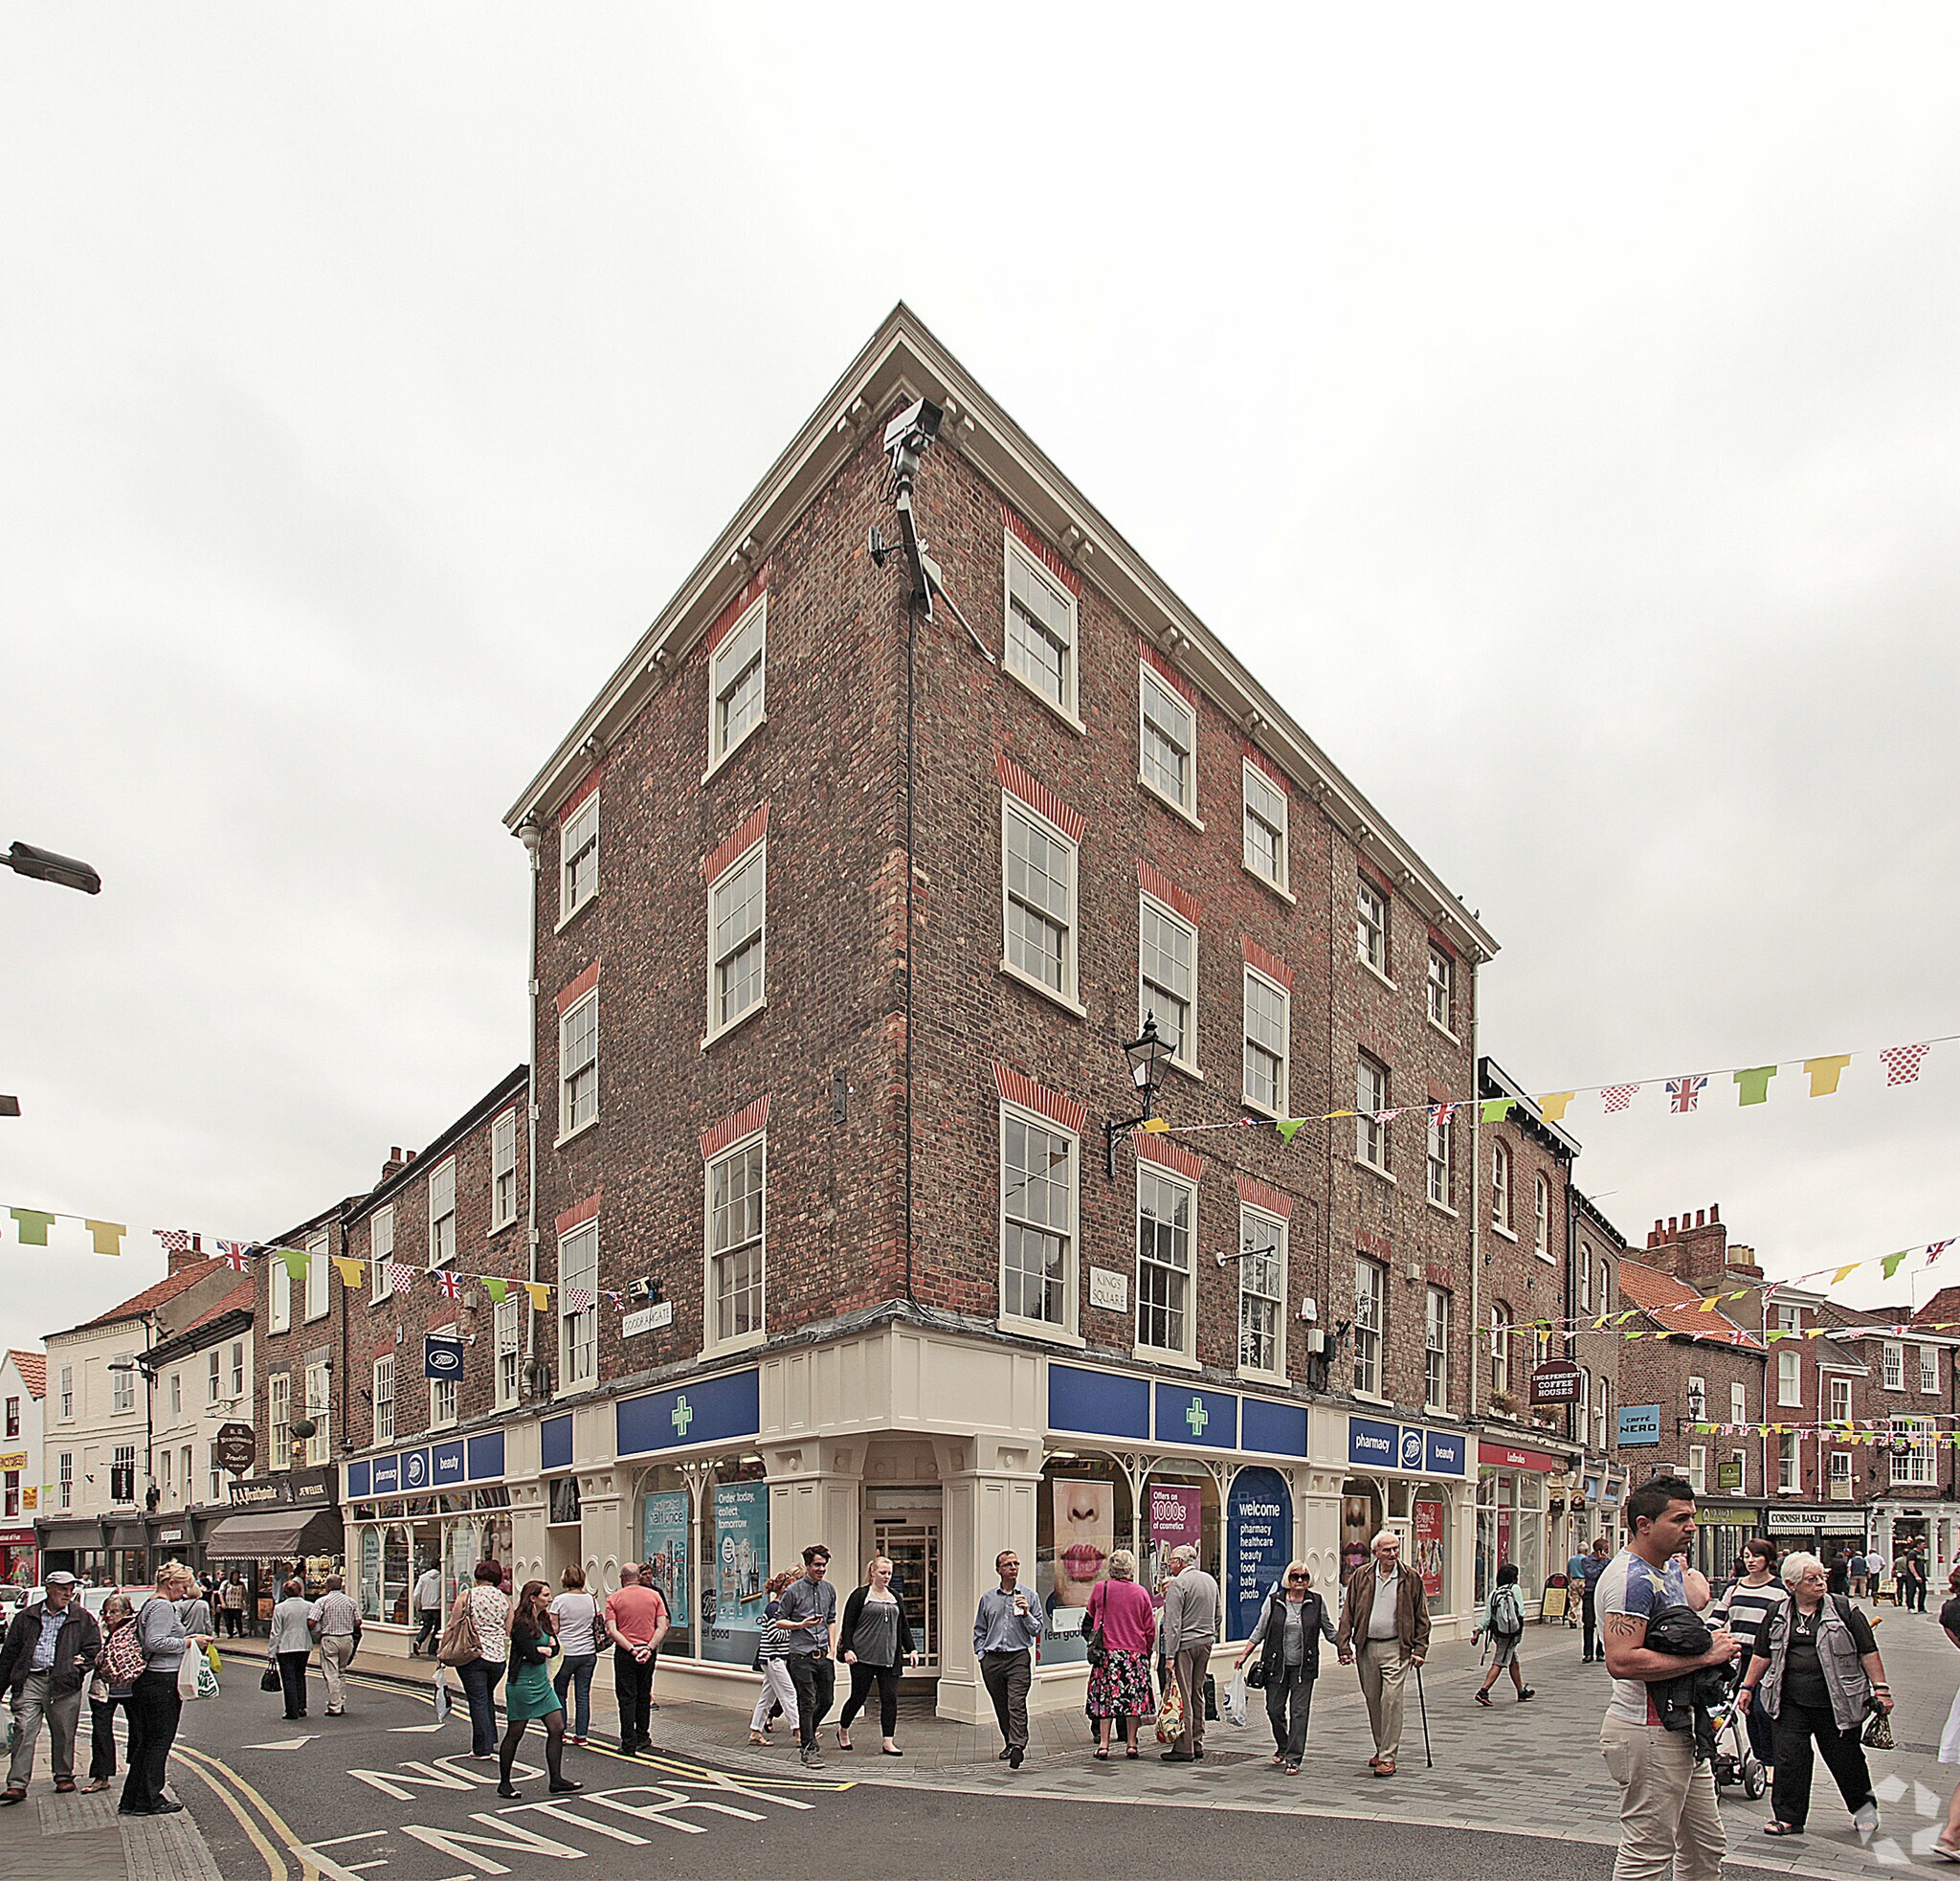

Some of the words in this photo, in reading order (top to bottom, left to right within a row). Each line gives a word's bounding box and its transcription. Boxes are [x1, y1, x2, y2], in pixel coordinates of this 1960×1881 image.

[1097, 1273, 1122, 1289] KINGS
[1093, 1288, 1125, 1307] SQUARE
[624, 1307, 670, 1332] GOODRAMGATE
[1532, 1372, 1581, 1381] INDEPENDENT
[1538, 1380, 1574, 1390] COFFEE
[1538, 1388, 1574, 1398] HOUSES
[1619, 1423, 1657, 1434] NERO
[1355, 1433, 1391, 1454] pharmacy
[1435, 1445, 1455, 1463] beauty
[375, 1468, 398, 1483] pharmacy
[439, 1455, 459, 1471] beauty
[718, 1493, 735, 1504] Order
[1153, 1490, 1170, 1500] Offers
[718, 1507, 739, 1517] collect
[1152, 1500, 1187, 1521] 1000s
[1239, 1500, 1281, 1517] welcome
[664, 1511, 684, 1527] price
[718, 1518, 747, 1530] tomorrow
[1771, 1513, 1800, 1523] CORNISH
[1801, 1513, 1828, 1523] BAKERY
[1159, 1522, 1185, 1531] cosmetics
[1240, 1524, 1272, 1536] pharmacy
[1240, 1536, 1274, 1548] healthcare
[1240, 1550, 1262, 1562] beauty
[1240, 1562, 1256, 1573] food
[1240, 1576, 1257, 1588] baby
[1240, 1589, 1259, 1602] photo
[711, 1629, 730, 1641] good
[1062, 1630, 1080, 1642] goo
[346, 1752, 546, 1801] NO
[289, 1771, 816, 1881] ENTRY
